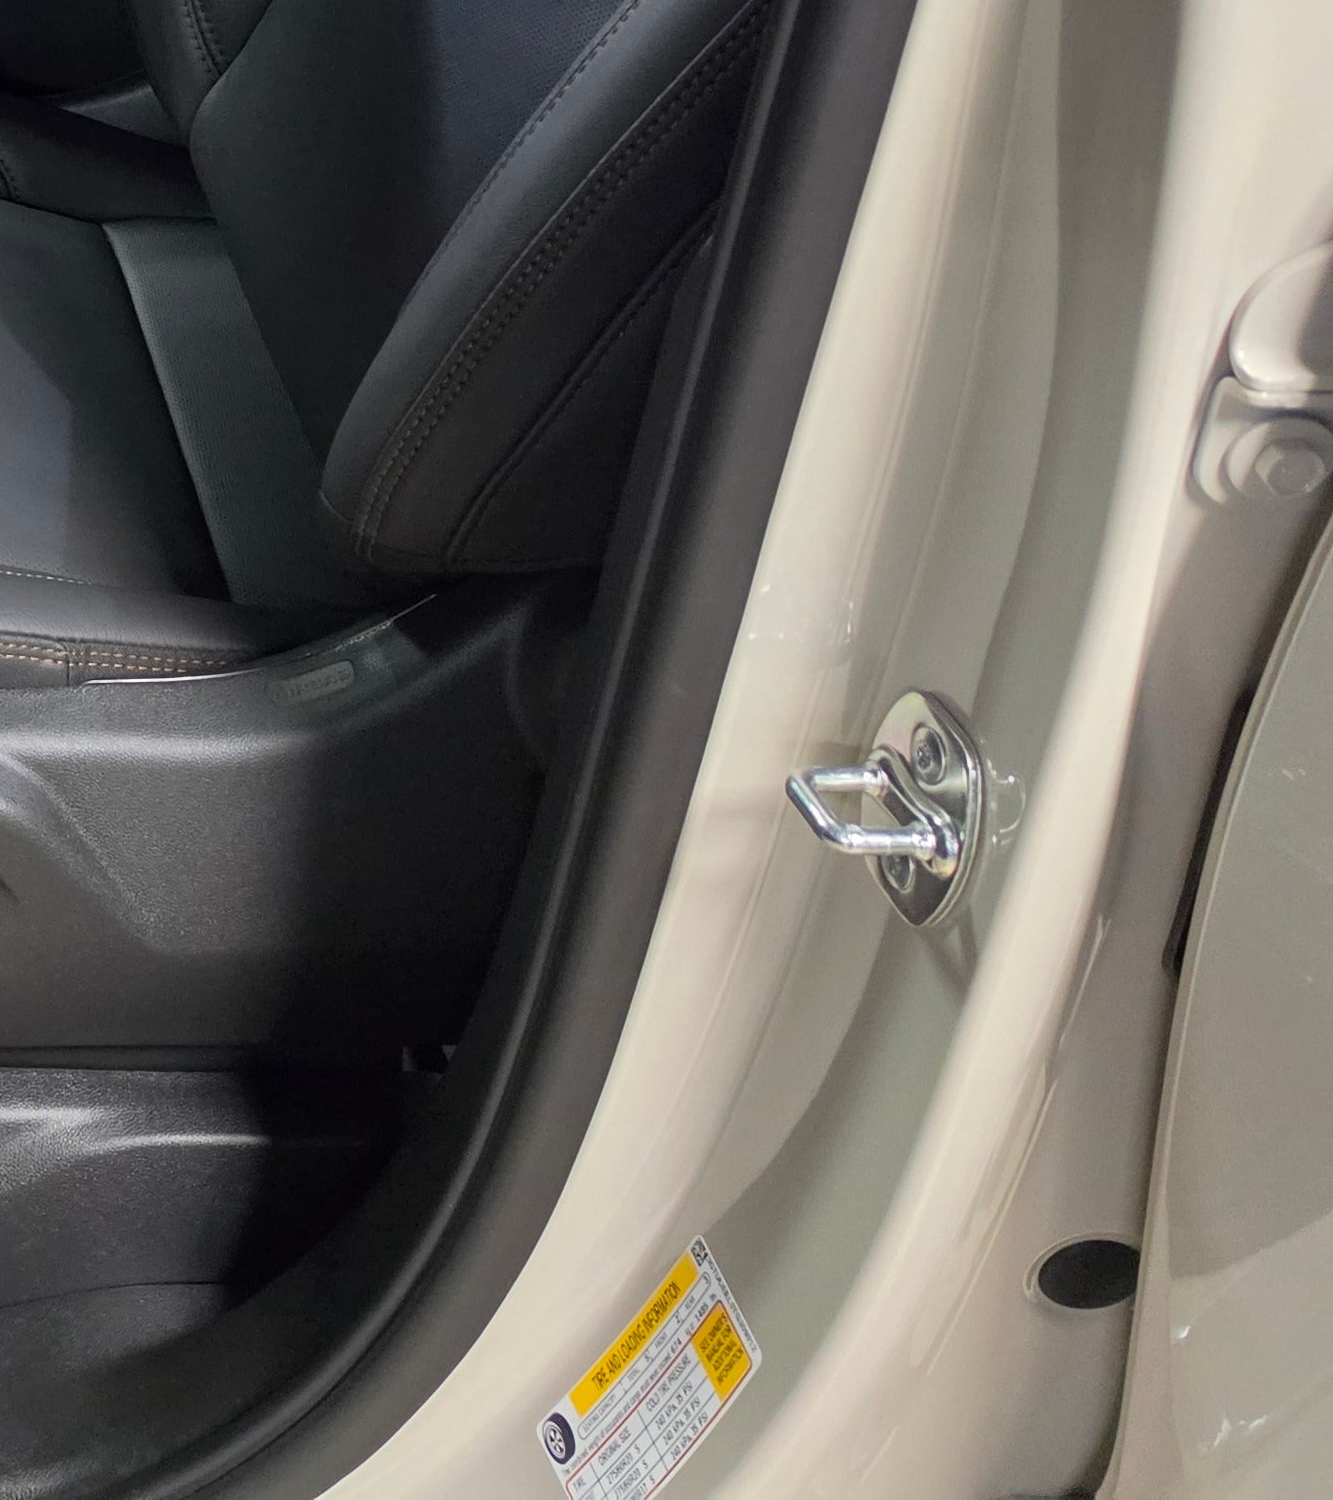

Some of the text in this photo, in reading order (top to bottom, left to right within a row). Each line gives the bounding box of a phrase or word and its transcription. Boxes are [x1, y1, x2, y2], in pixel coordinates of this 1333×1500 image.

[592, 1280, 682, 1392] TIRE AND LOADING INFORMATION
[670, 1337, 682, 1354] 674
